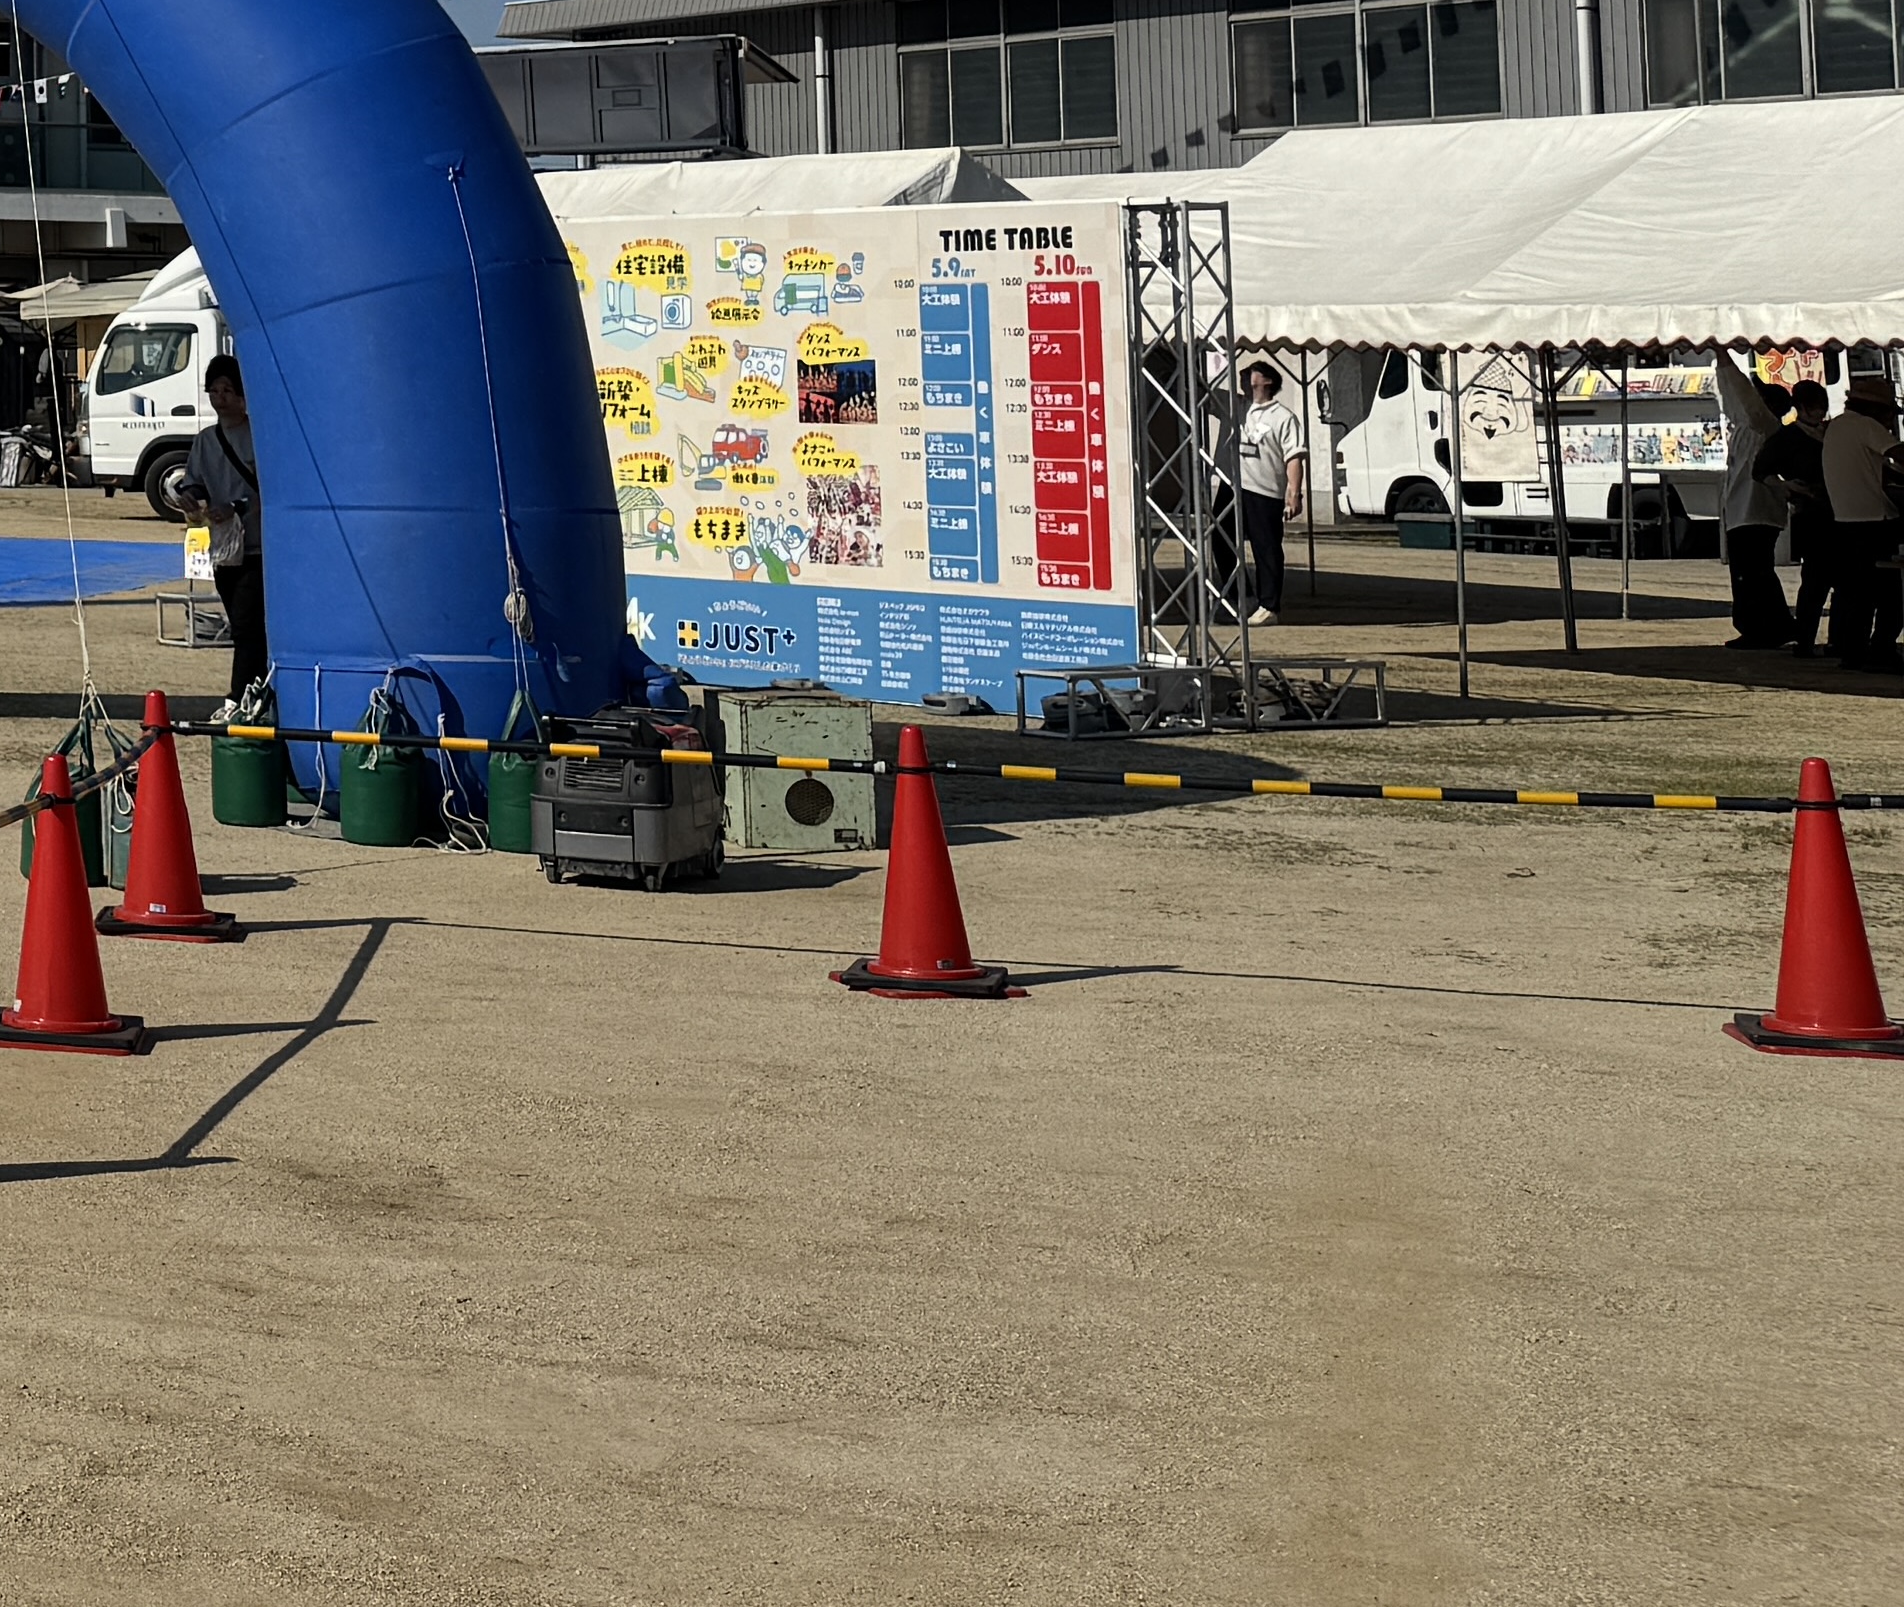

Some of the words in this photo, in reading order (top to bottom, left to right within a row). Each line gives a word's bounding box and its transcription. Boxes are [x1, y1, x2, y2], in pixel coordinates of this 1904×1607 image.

[939, 227, 997, 252] TIME
[1004, 225, 1073, 250] TABLE
[615, 253, 684, 276] 住宅設備
[788, 258, 835, 271] キッチンカー
[931, 256, 961, 279] 5.9
[1034, 254, 1076, 276] 5.10
[693, 518, 746, 541] もちまき
